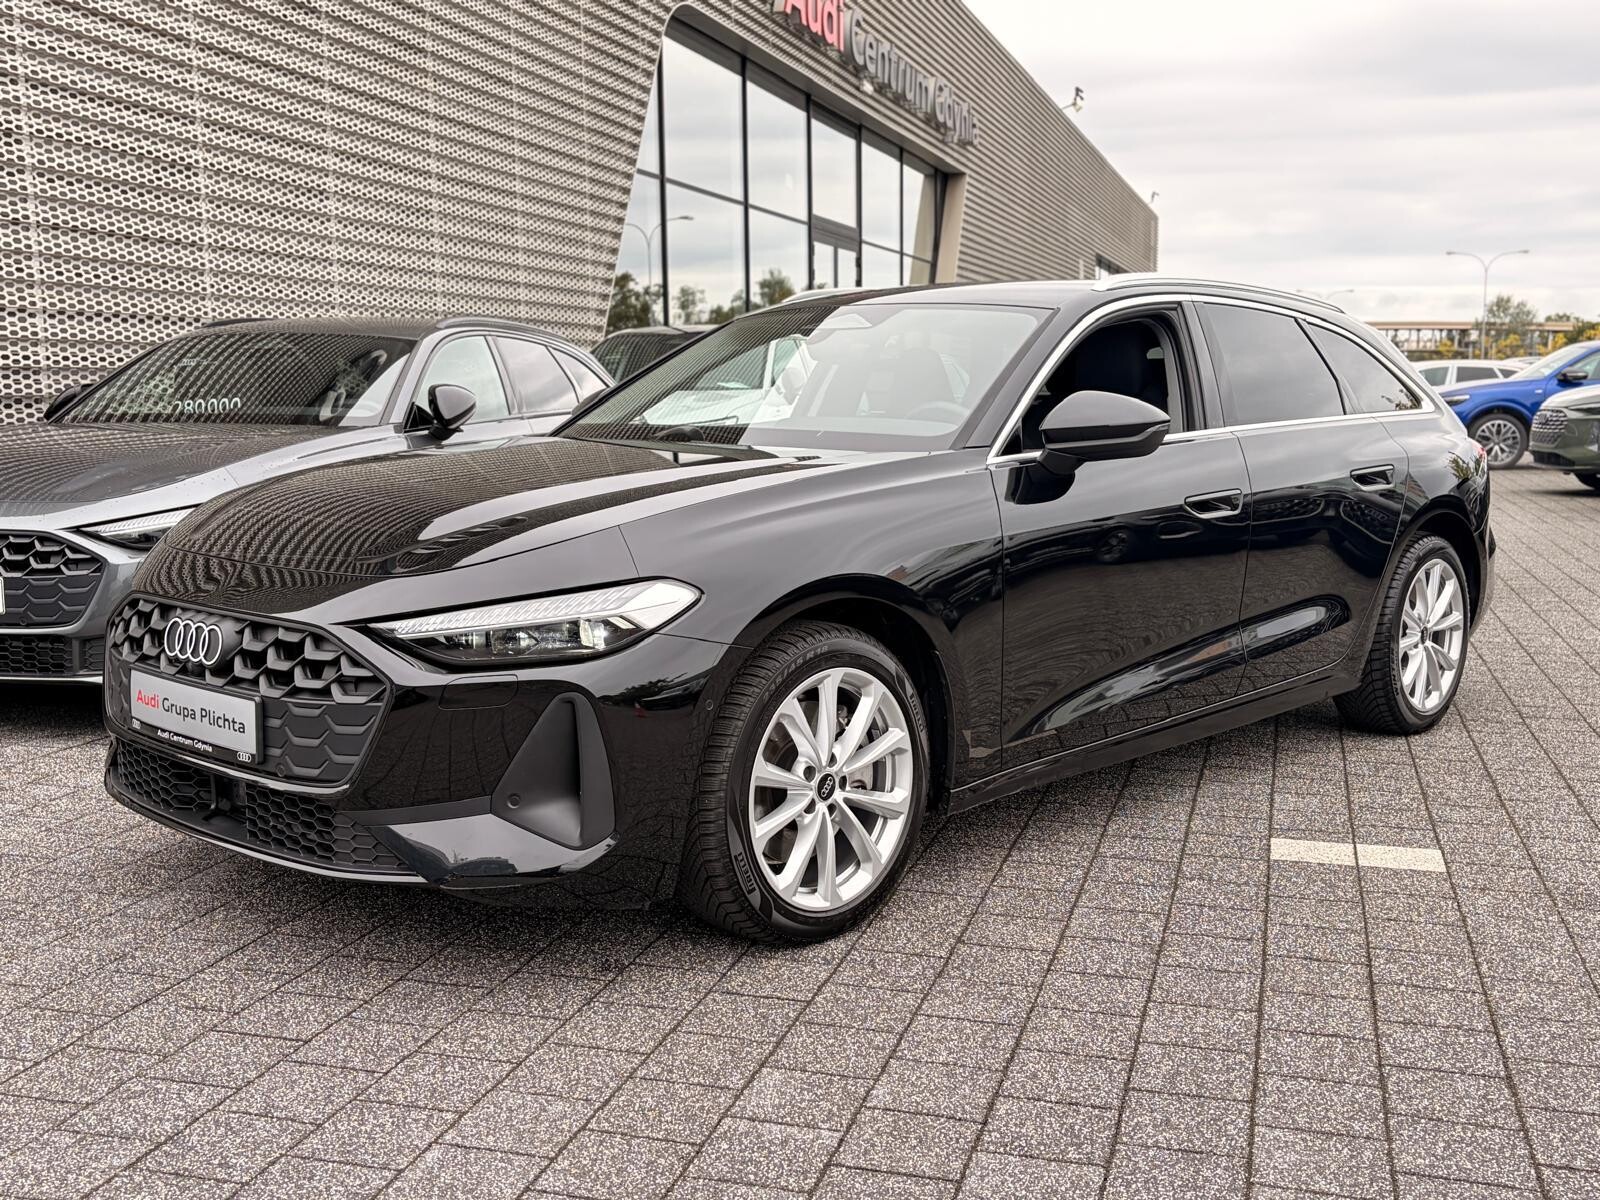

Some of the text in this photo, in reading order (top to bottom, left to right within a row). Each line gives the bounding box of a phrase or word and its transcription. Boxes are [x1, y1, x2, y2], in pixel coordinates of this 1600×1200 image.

[851, 7, 936, 113] Centrum
[935, 79, 978, 145] Gdynia
[136, 689, 246, 734] Audi Grupa Plichta
[157, 729, 213, 752] Audi Centrum Gdynia
[734, 851, 758, 895] PIRELLI
